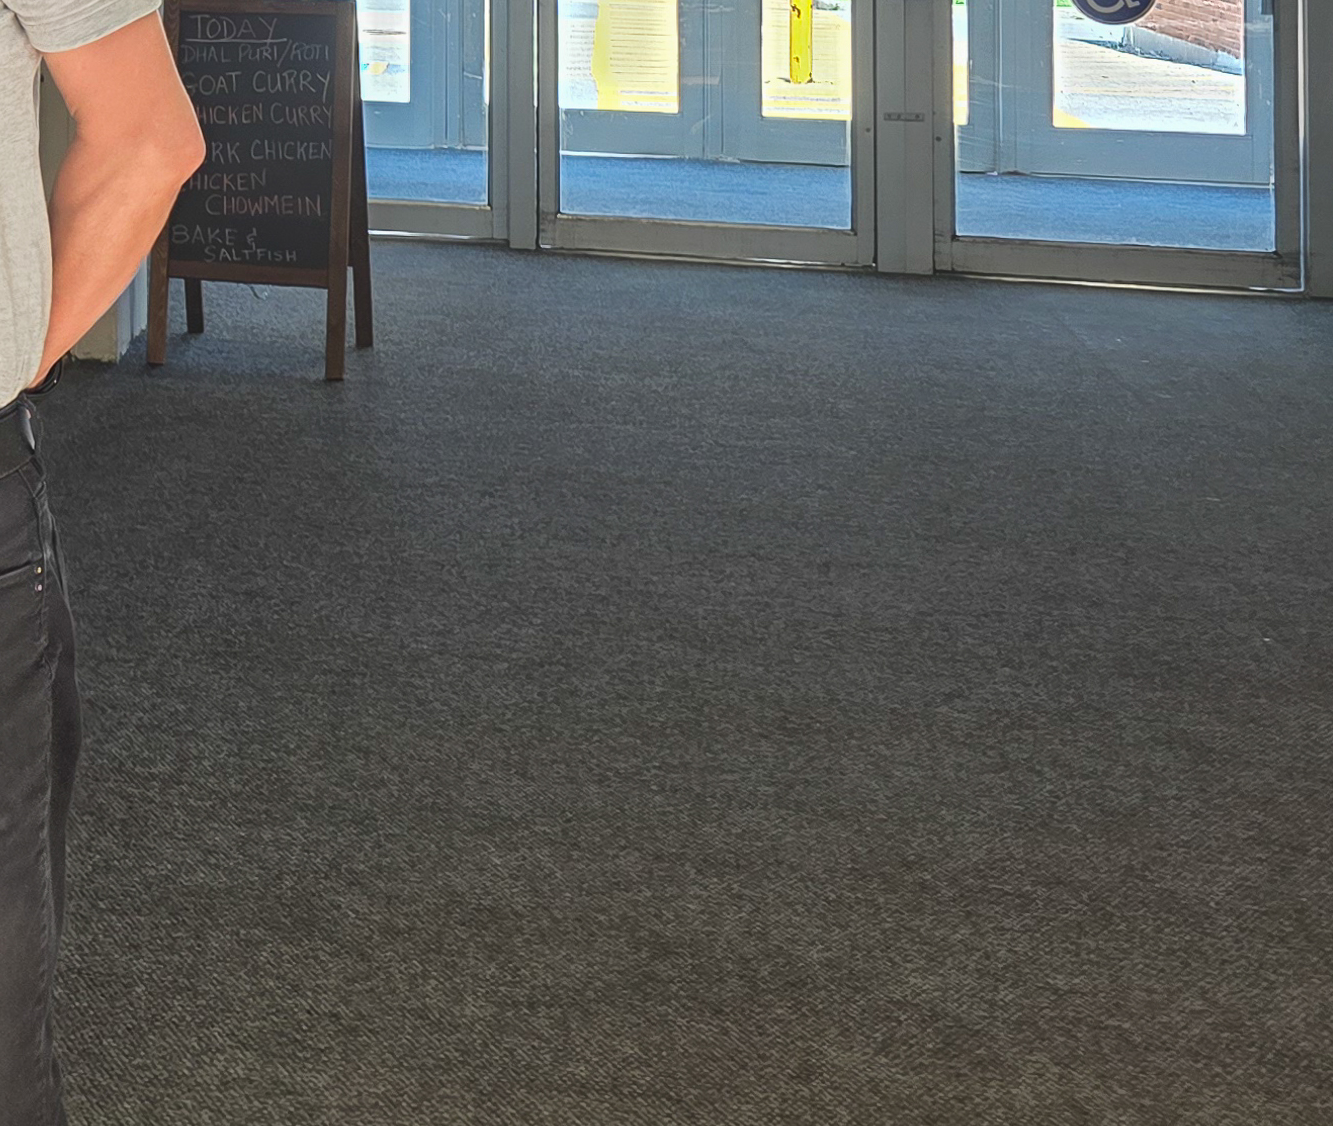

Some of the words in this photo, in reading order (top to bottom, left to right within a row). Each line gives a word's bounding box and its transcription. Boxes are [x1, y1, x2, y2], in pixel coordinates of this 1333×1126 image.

[186, 14, 278, 40] TODAY
[181, 44, 232, 65] DHAL
[252, 69, 332, 98] CURRY
[194, 102, 264, 126] HICKEN
[269, 103, 333, 129] CURRY
[210, 140, 241, 165] RK
[250, 138, 332, 162] CHICKEN
[182, 167, 268, 193] HICKEN
[204, 193, 323, 218] CHOWMEIN
[171, 224, 237, 247] BAKE
[203, 246, 298, 265] SALTFISH
